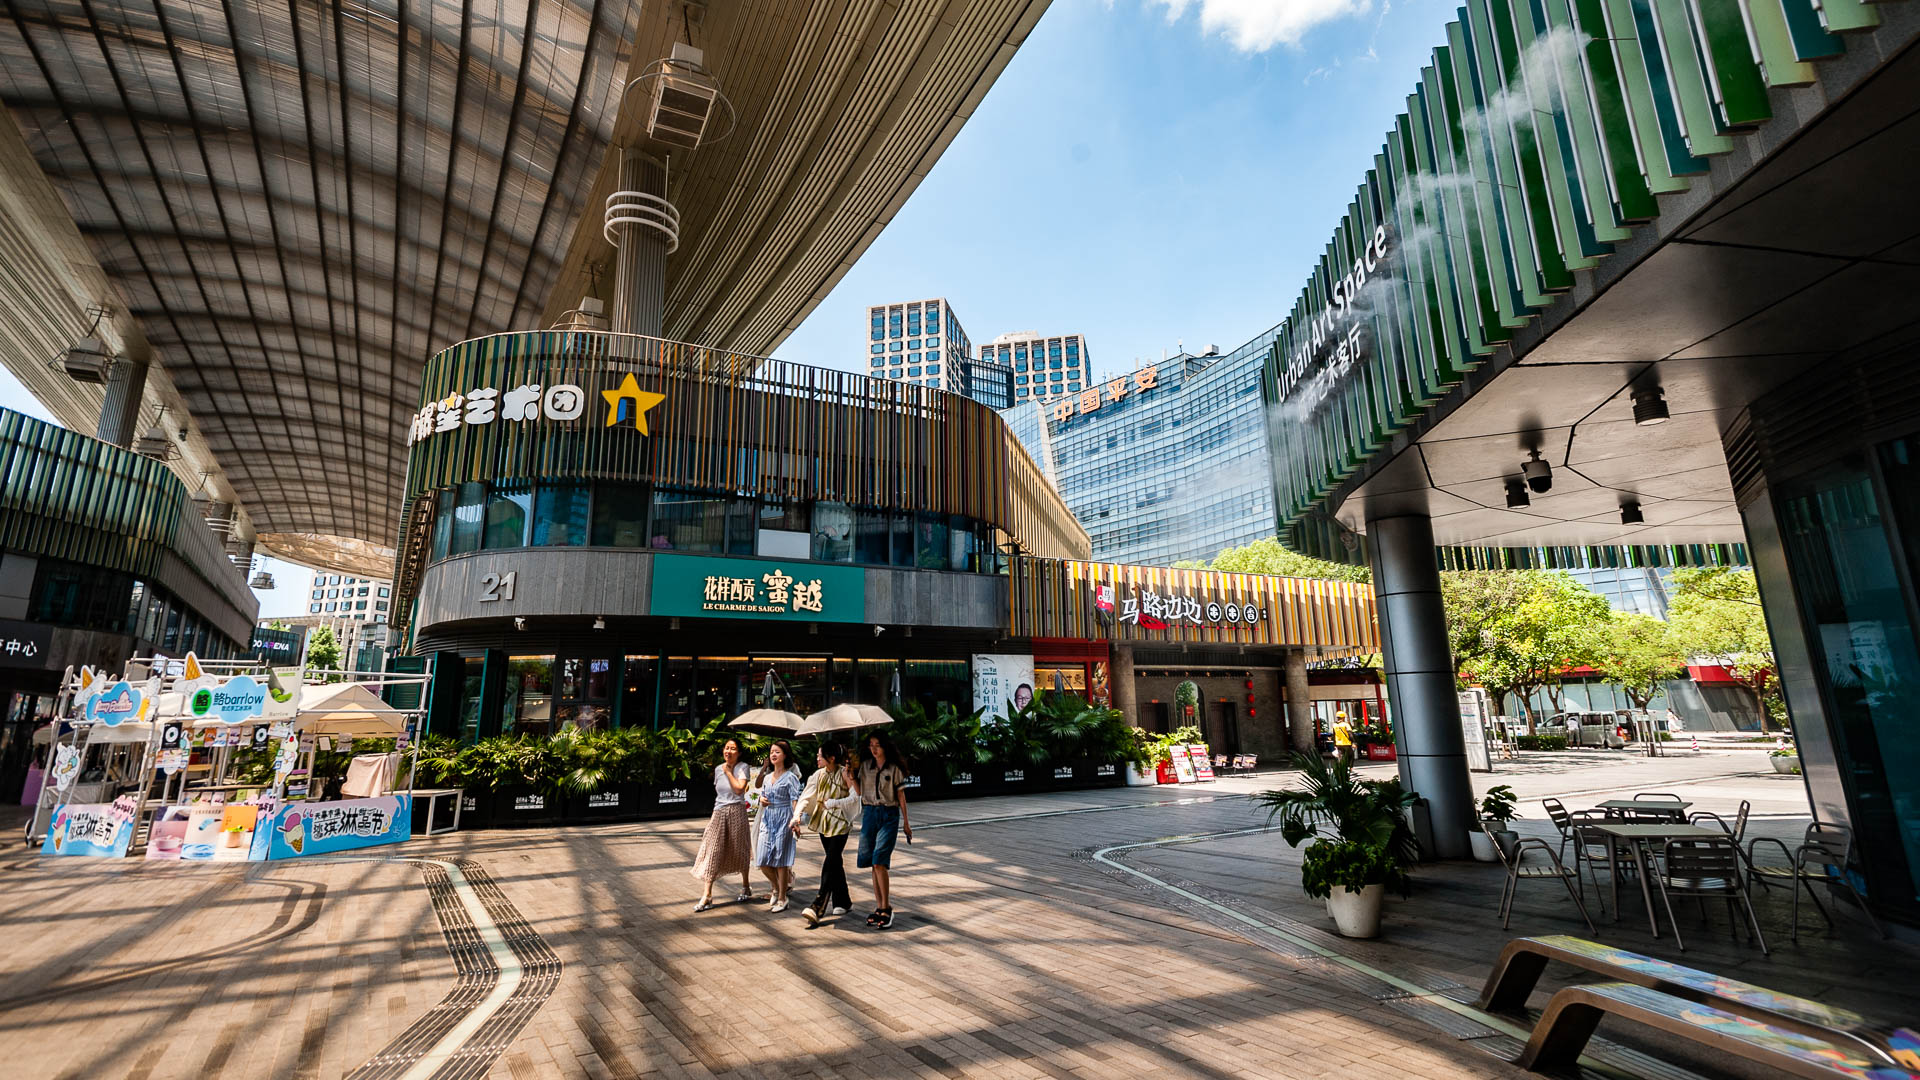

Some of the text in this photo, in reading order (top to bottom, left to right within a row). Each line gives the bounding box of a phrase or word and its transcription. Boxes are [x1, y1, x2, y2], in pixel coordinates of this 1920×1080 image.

[1277, 224, 1387, 403] Urban Art Space
[1054, 366, 1158, 421] 中国平安
[479, 572, 517, 602] 21
[714, 603, 747, 611] CHARME
[747, 604, 758, 612] DE
[758, 605, 785, 613] SAIGON
[262, 641, 289, 651] ARENA
